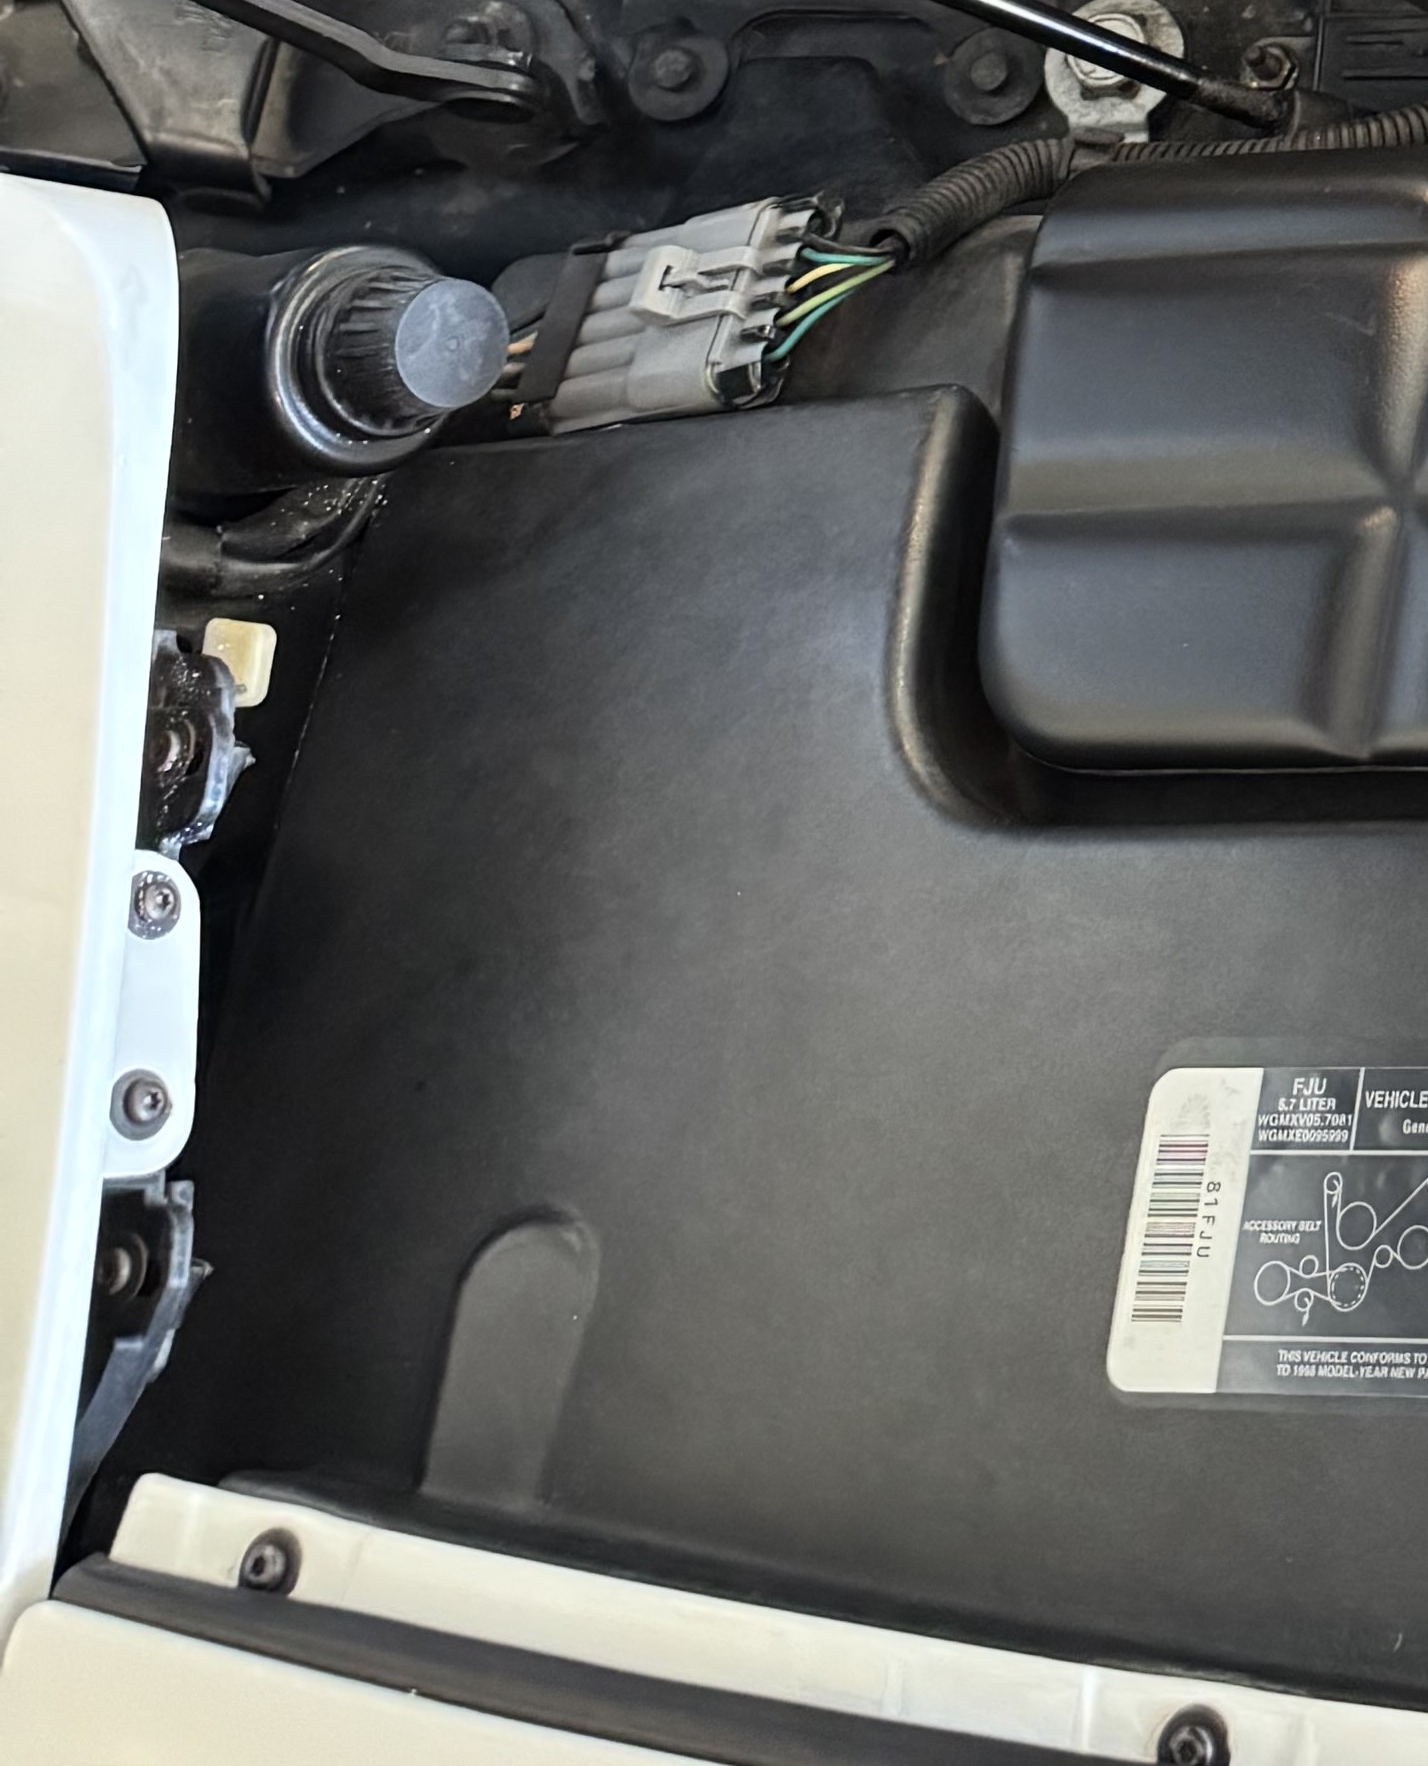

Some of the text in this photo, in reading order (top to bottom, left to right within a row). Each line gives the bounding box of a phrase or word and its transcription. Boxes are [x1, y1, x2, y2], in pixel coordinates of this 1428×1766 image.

[1293, 1078, 1327, 1095] FJU
[1278, 1098, 1336, 1111] 5.7 LITER
[1365, 1090, 1428, 1108] VEHICLE
[1196, 1181, 1222, 1259] 81FJU
[1243, 1220, 1297, 1231] ACCESSORY
[1259, 1233, 1301, 1244] ROUTING
[1278, 1350, 1301, 1363] THIS
[1303, 1350, 1348, 1364] VEHICLE
[1350, 1351, 1410, 1365] CONFORMS
[1413, 1352, 1427, 1364] TO
[1276, 1364, 1291, 1376] TO
[1390, 1366, 1415, 1379] NEW
